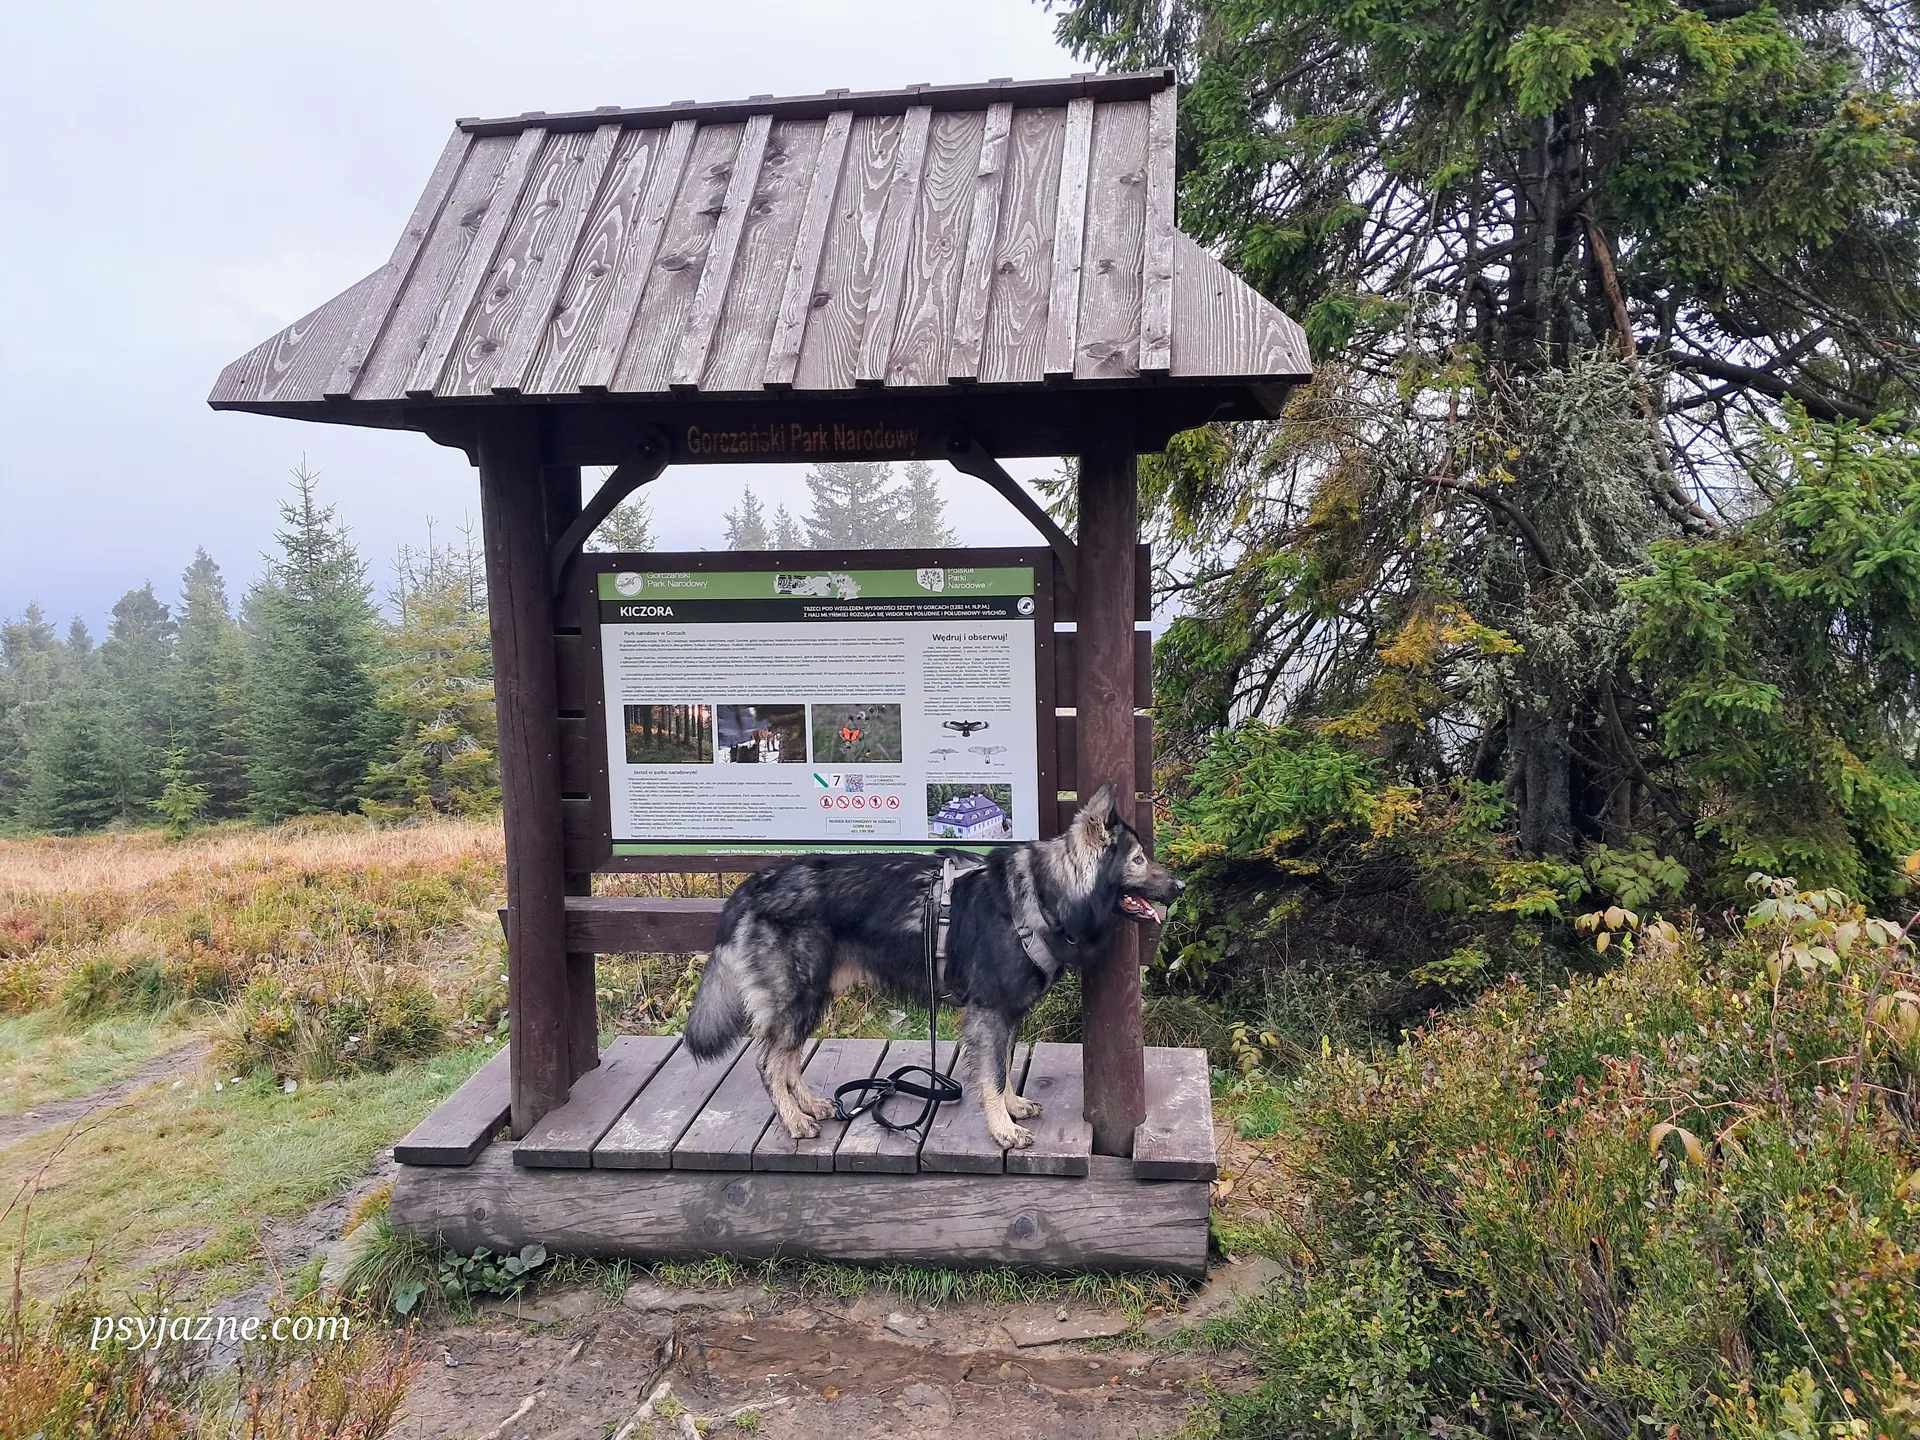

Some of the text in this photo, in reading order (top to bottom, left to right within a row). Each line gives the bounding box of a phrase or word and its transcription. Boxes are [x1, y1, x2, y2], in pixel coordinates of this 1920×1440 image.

[687, 422, 918, 456] Gorczański Park Narodowy
[647, 579, 708, 589] Park Narodowy
[948, 581, 986, 589] Narodowe
[620, 606, 674, 617] KICZORA
[932, 632, 1008, 642] Wędruj i obserwuj!
[833, 775, 841, 787] 7
